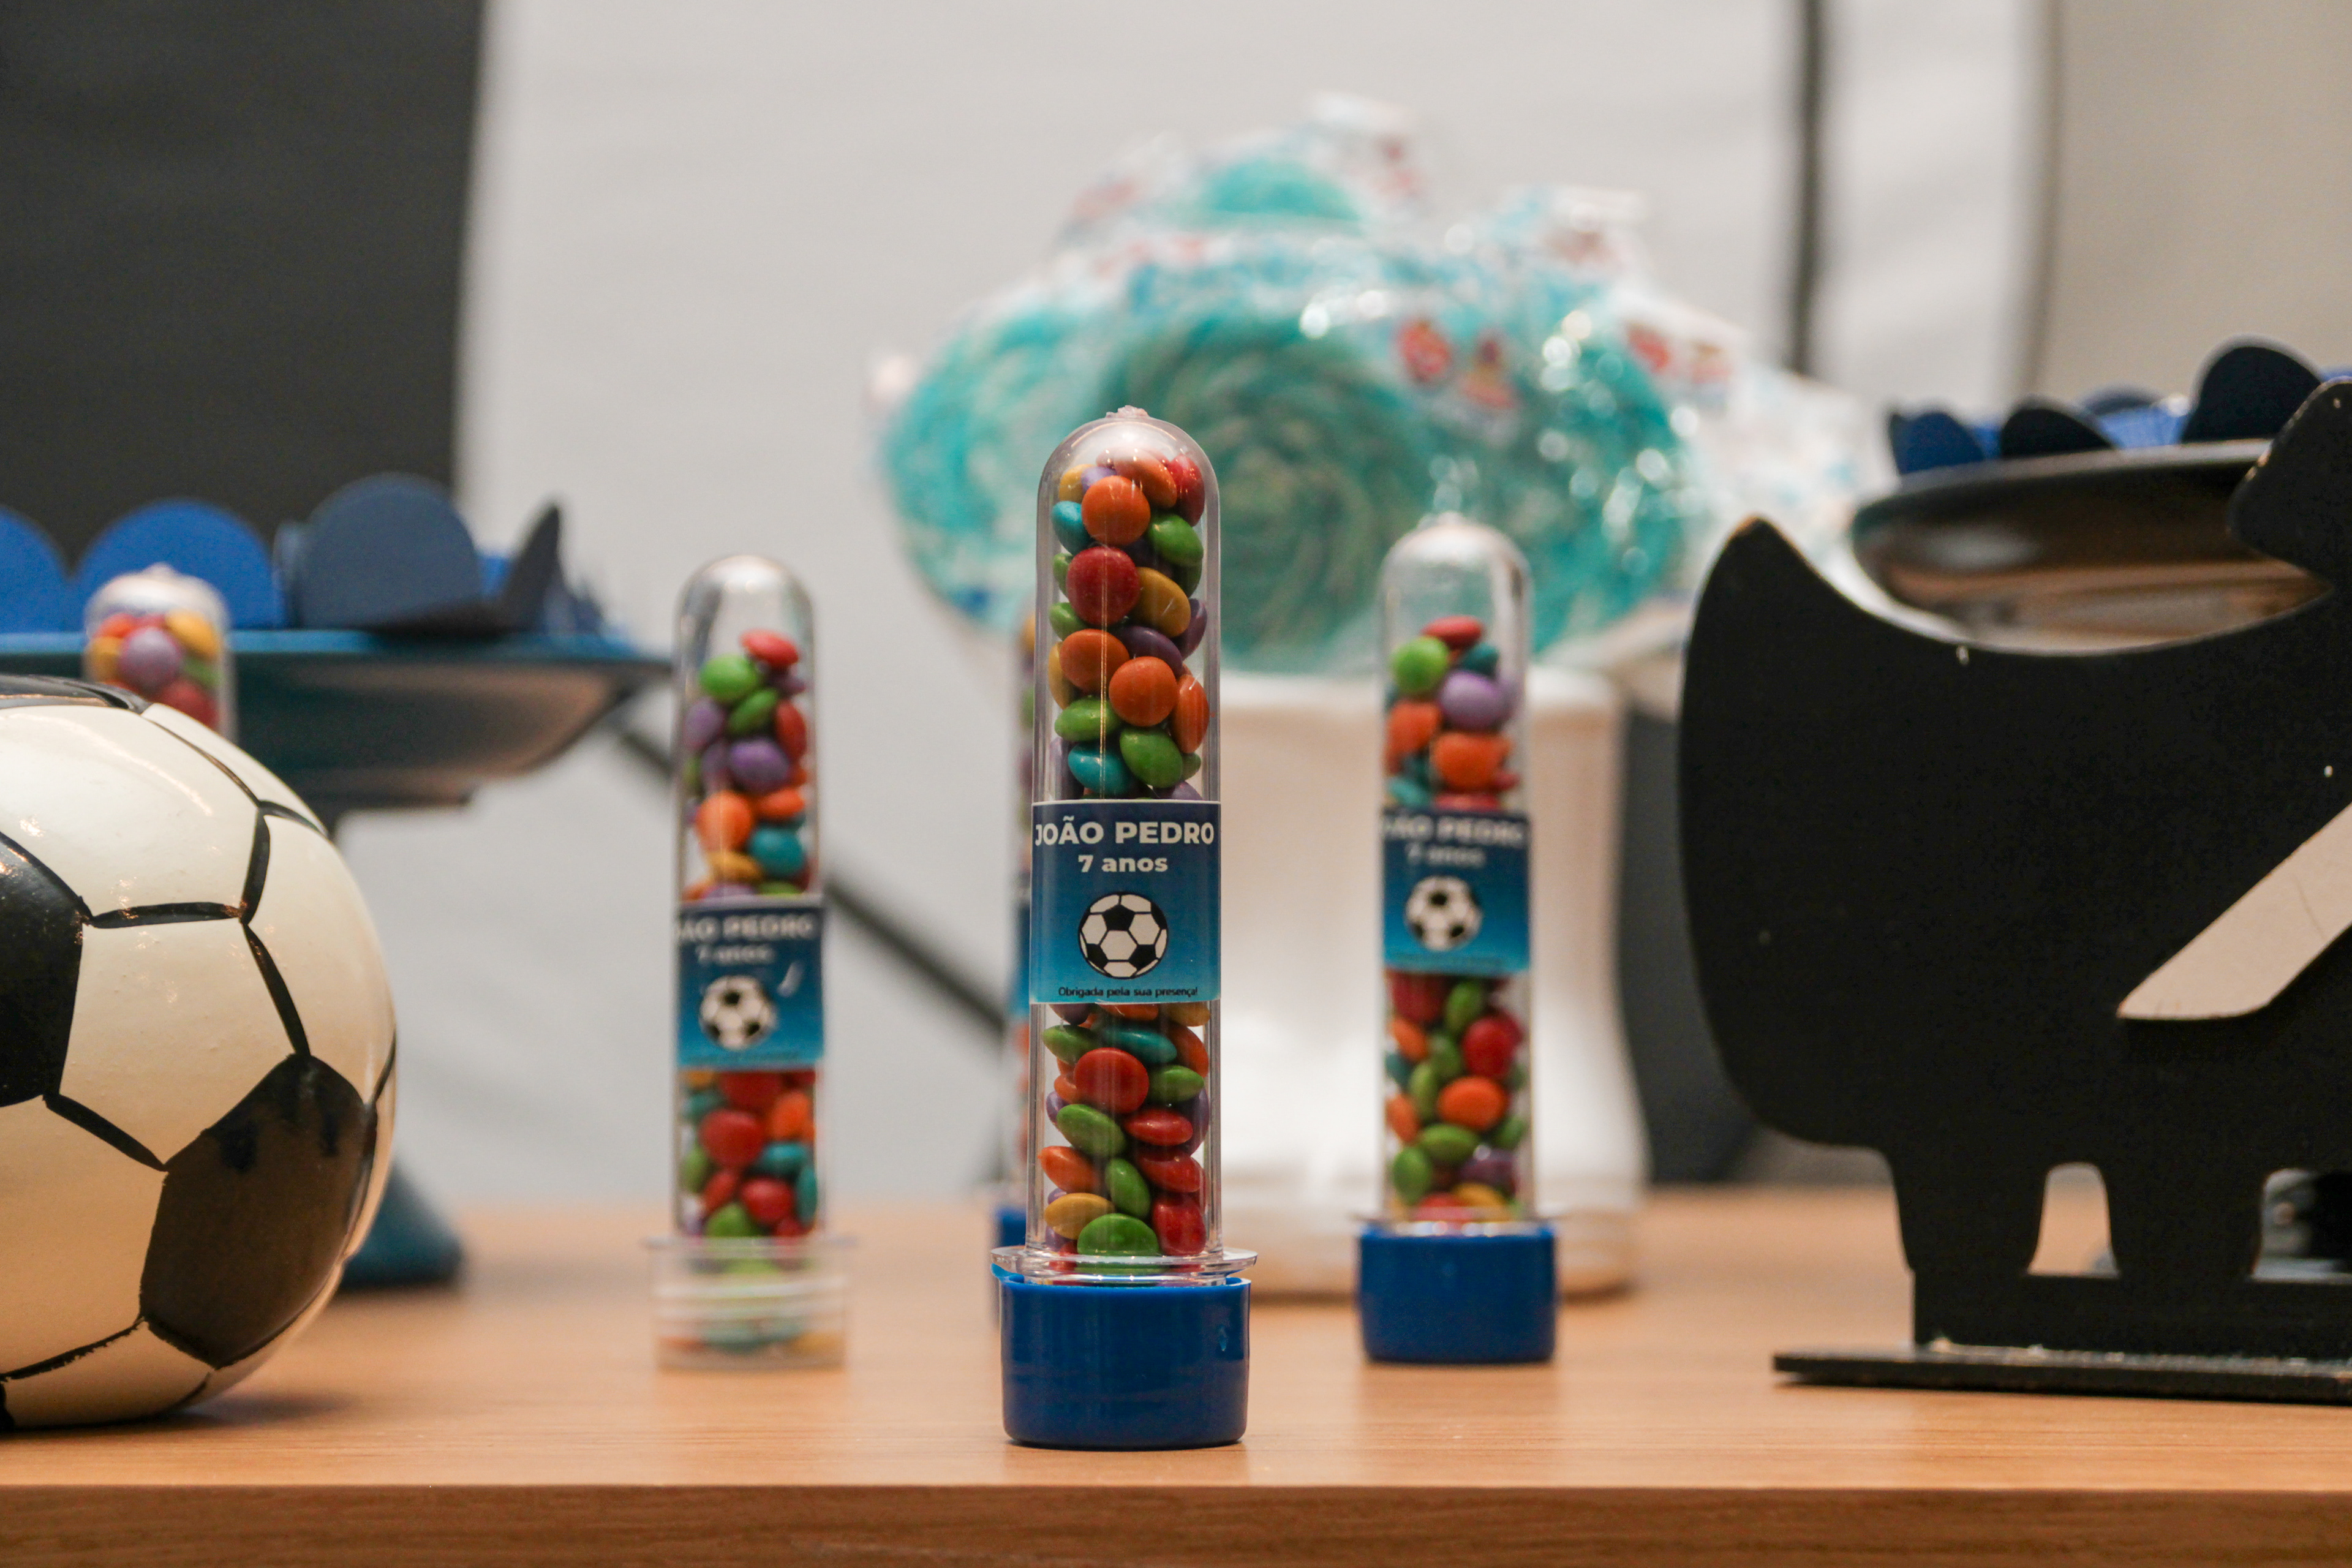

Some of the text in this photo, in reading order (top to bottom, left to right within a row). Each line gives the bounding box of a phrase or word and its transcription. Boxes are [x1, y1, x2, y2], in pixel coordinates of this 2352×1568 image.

[1035, 815, 1215, 846] JOÃO PEDRO
[1078, 854, 1169, 873] 7 anos
[1058, 986, 1104, 998] Obrigada
[1106, 986, 1131, 998] pela
[1133, 987, 1153, 997] sua
